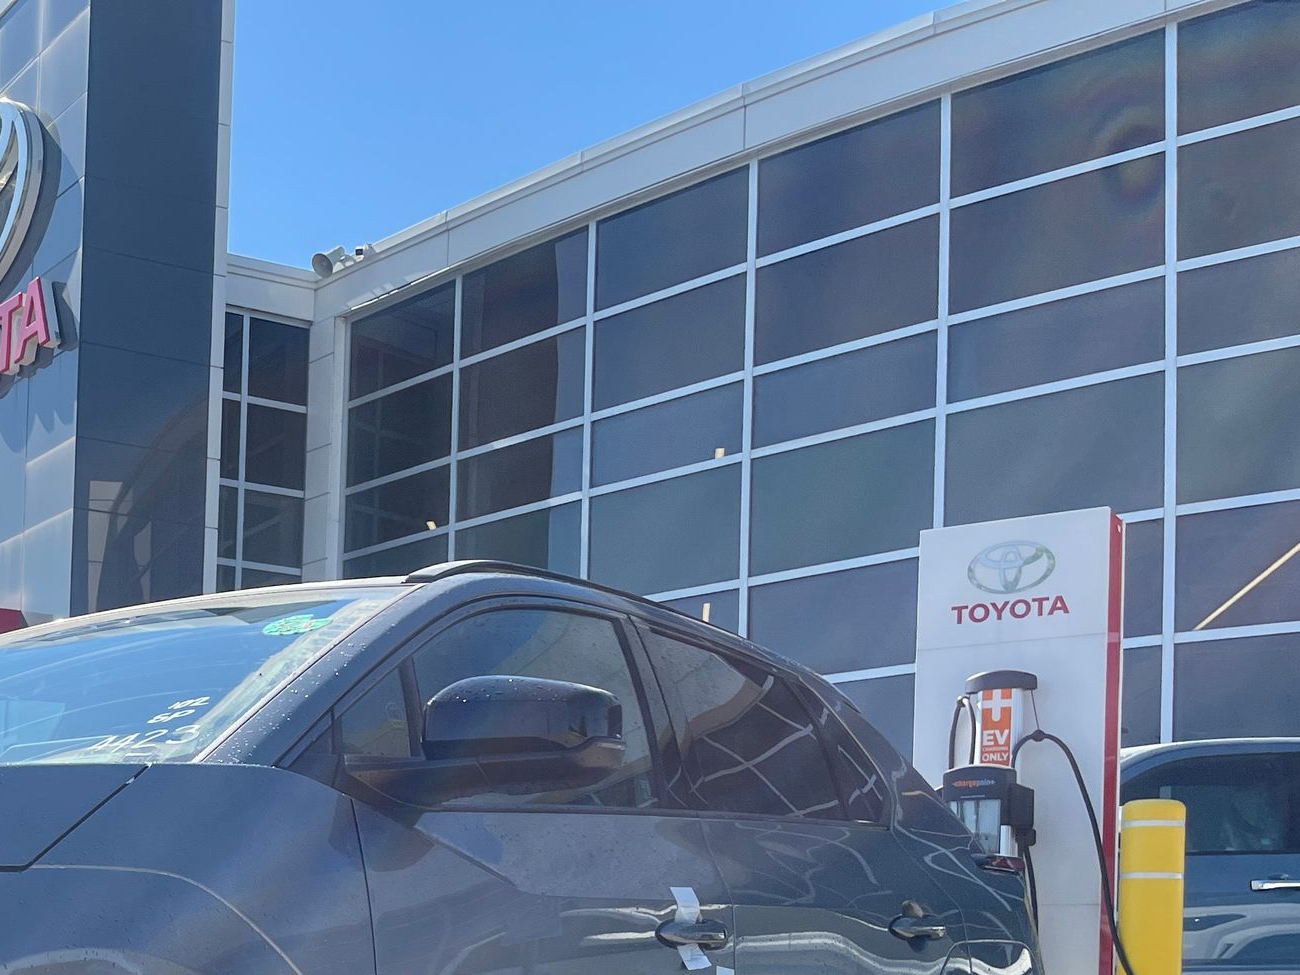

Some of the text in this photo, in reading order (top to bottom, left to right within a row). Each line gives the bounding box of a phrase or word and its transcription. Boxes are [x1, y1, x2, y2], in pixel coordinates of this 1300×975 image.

[950, 594, 1070, 625] TOYOTA
[982, 729, 1010, 746] EV
[981, 752, 1009, 762] ONLY
